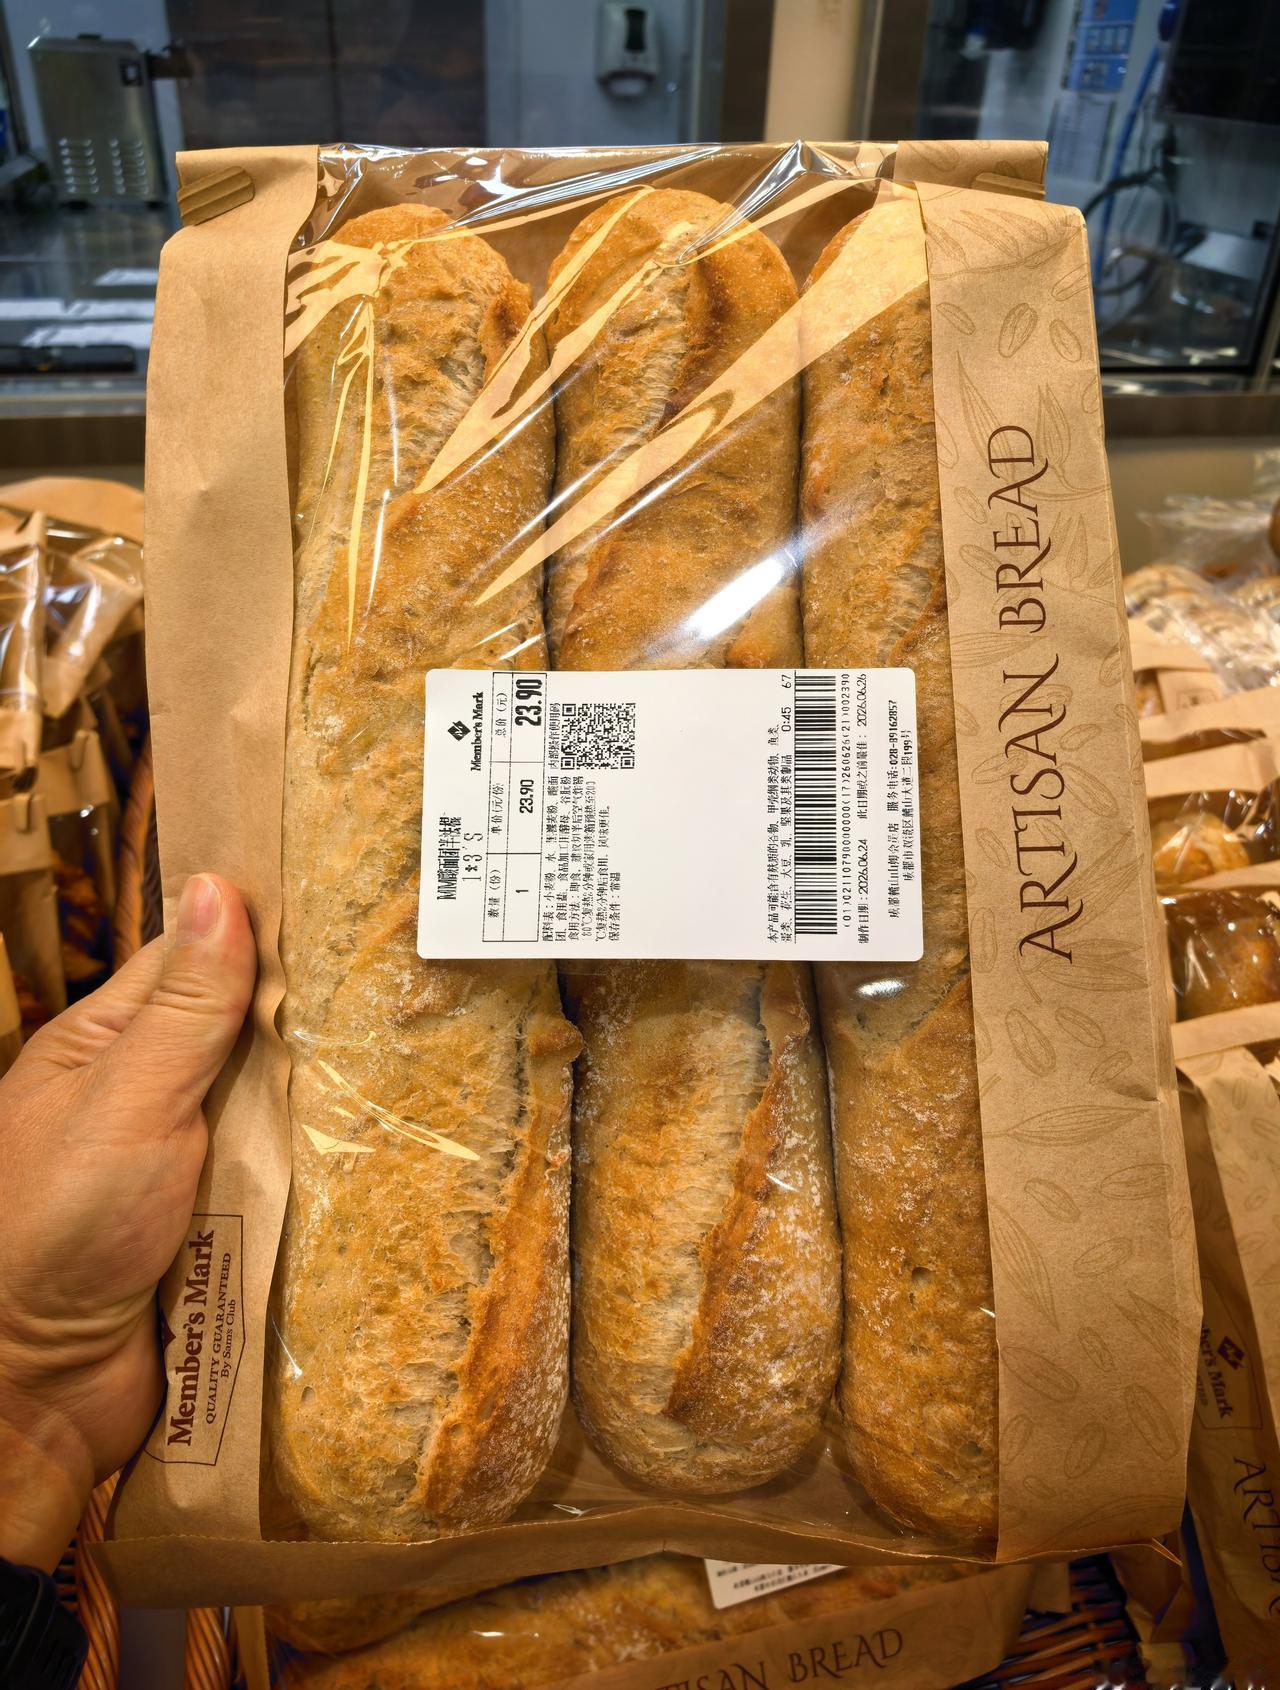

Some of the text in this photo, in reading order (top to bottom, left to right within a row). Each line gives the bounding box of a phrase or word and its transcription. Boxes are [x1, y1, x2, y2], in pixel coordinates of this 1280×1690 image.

[515, 679, 544, 726] 23.90
[781, 674, 791, 688] 67
[856, 674, 867, 727] 2026.06.26
[987, 425, 1084, 964] ARTISAN BREAD
[470, 691, 483, 771] Member's Mark
[781, 707, 791, 732] 0:45
[519, 779, 534, 814] 23.90
[166, 1229, 215, 1447] Member's Mark
[205, 1251, 232, 1425] QUALITY GUARANTEED
[225, 1299, 237, 1328] Club
[220, 1363, 231, 1379] By
[787, 1627, 904, 1684] BREAD
